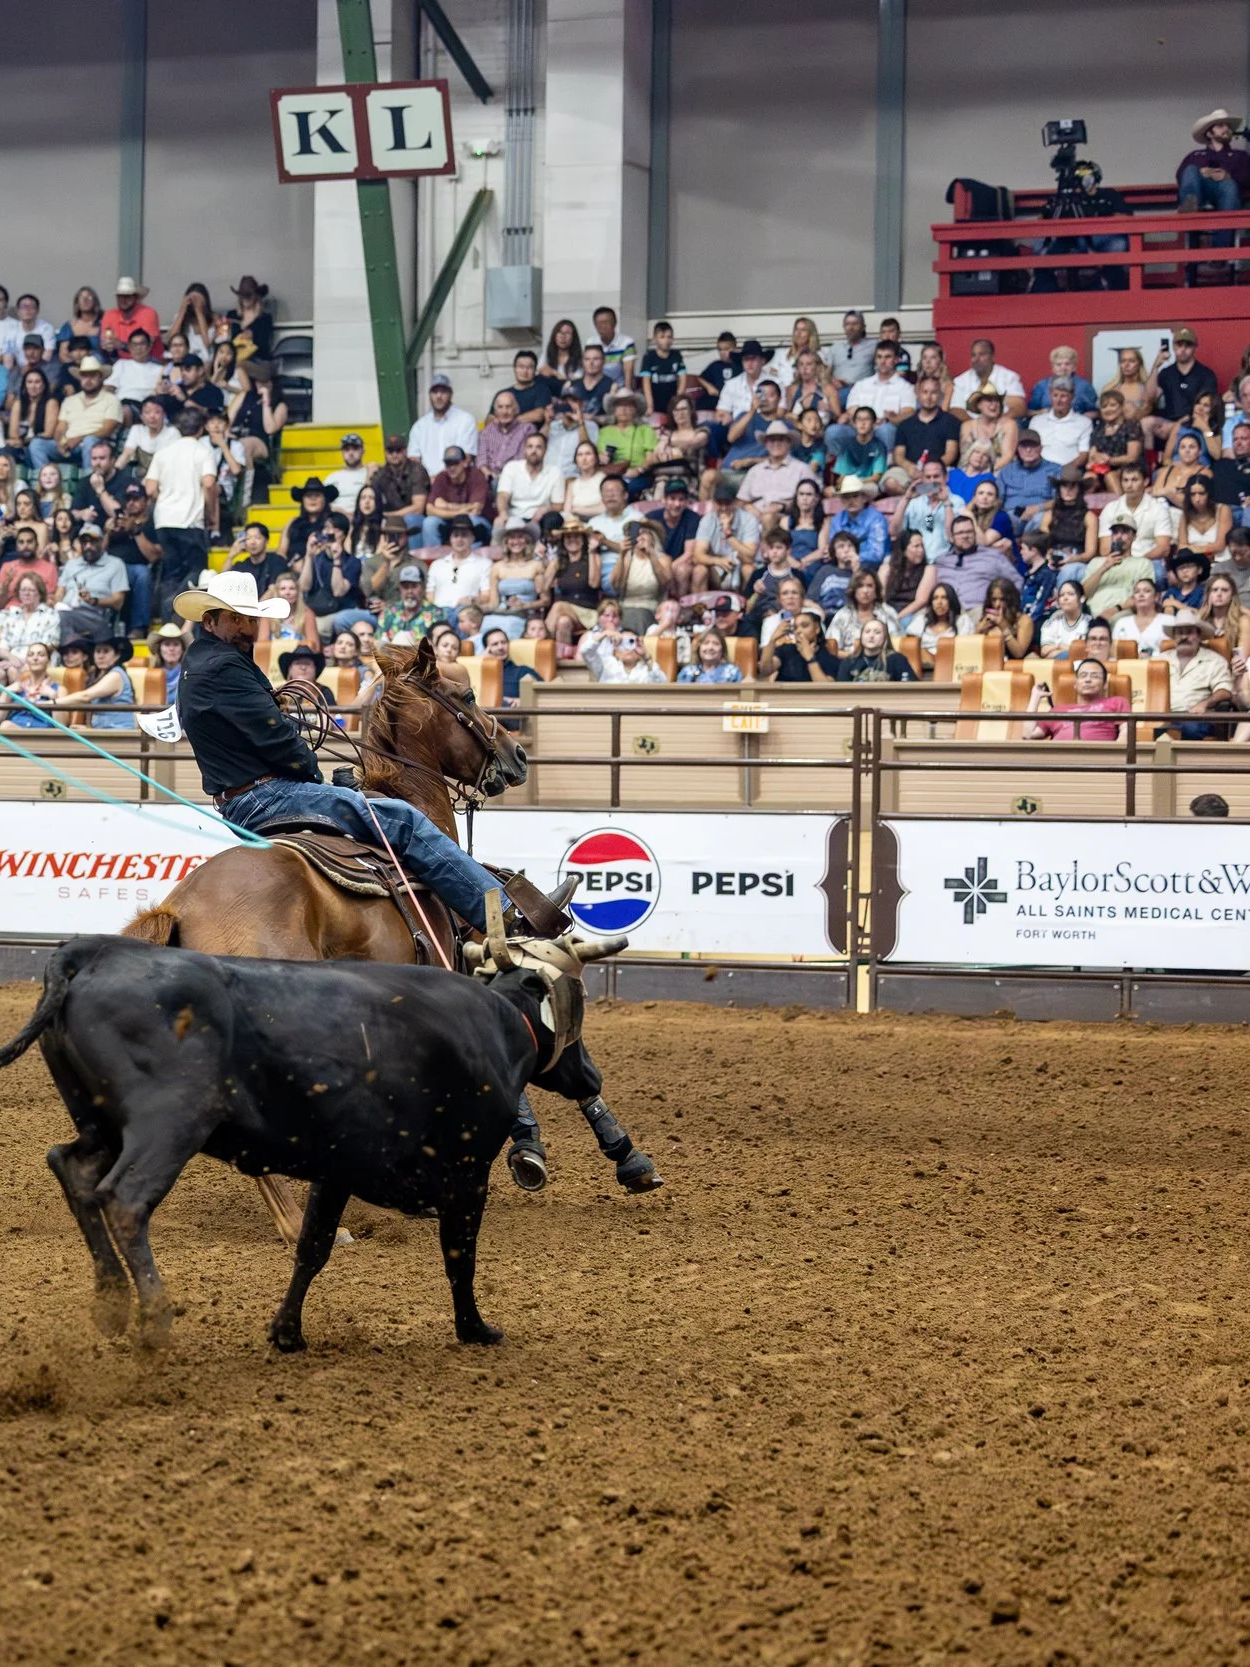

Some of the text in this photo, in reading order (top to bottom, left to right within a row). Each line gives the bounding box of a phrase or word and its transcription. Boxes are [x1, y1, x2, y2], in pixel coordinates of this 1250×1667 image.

[286, 104, 432, 156] K L
[692, 871, 794, 897] PEPSI
[57, 886, 150, 901] SAFES
[1016, 904, 1250, 921] ALL SAINTS MEDICAL CEN
[1015, 929, 1097, 940] FORT WORTH
